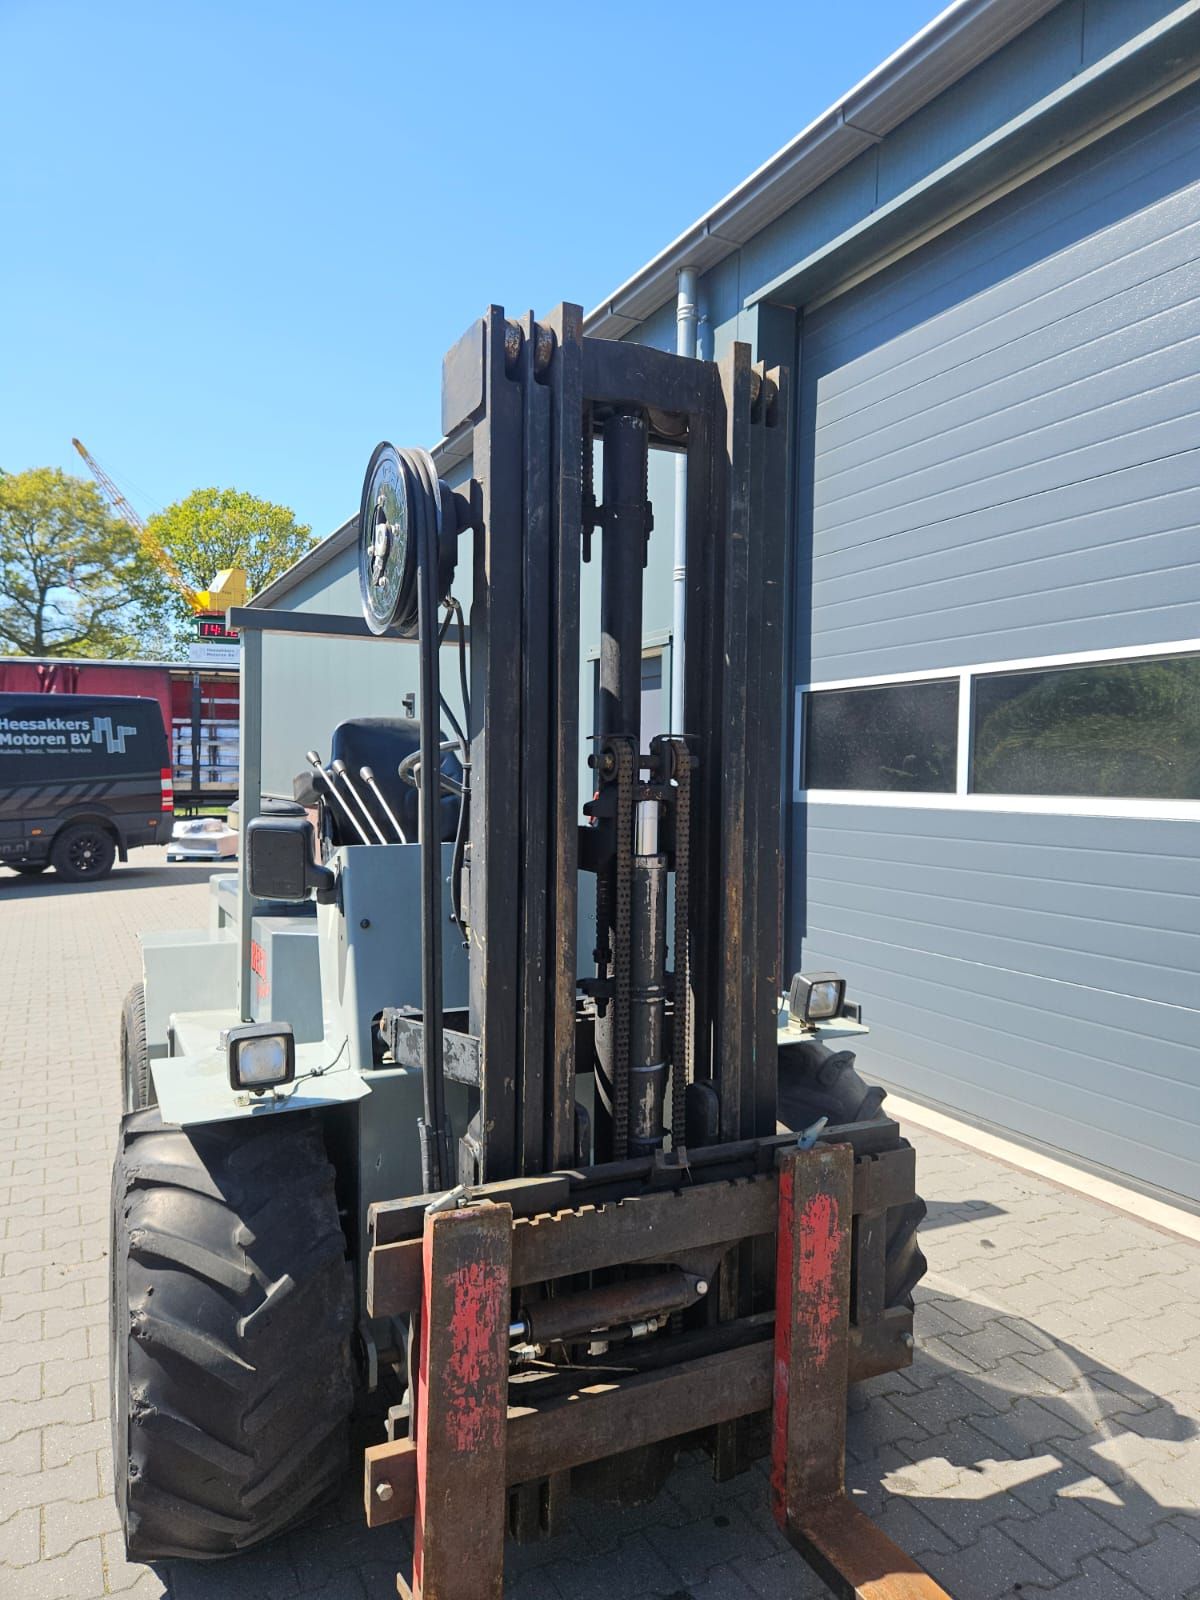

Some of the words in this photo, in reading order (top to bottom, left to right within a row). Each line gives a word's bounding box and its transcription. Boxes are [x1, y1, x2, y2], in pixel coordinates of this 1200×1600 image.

[0, 718, 90, 730] Heesakkers
[0, 733, 66, 745] Motoren
[70, 733, 91, 745] BV
